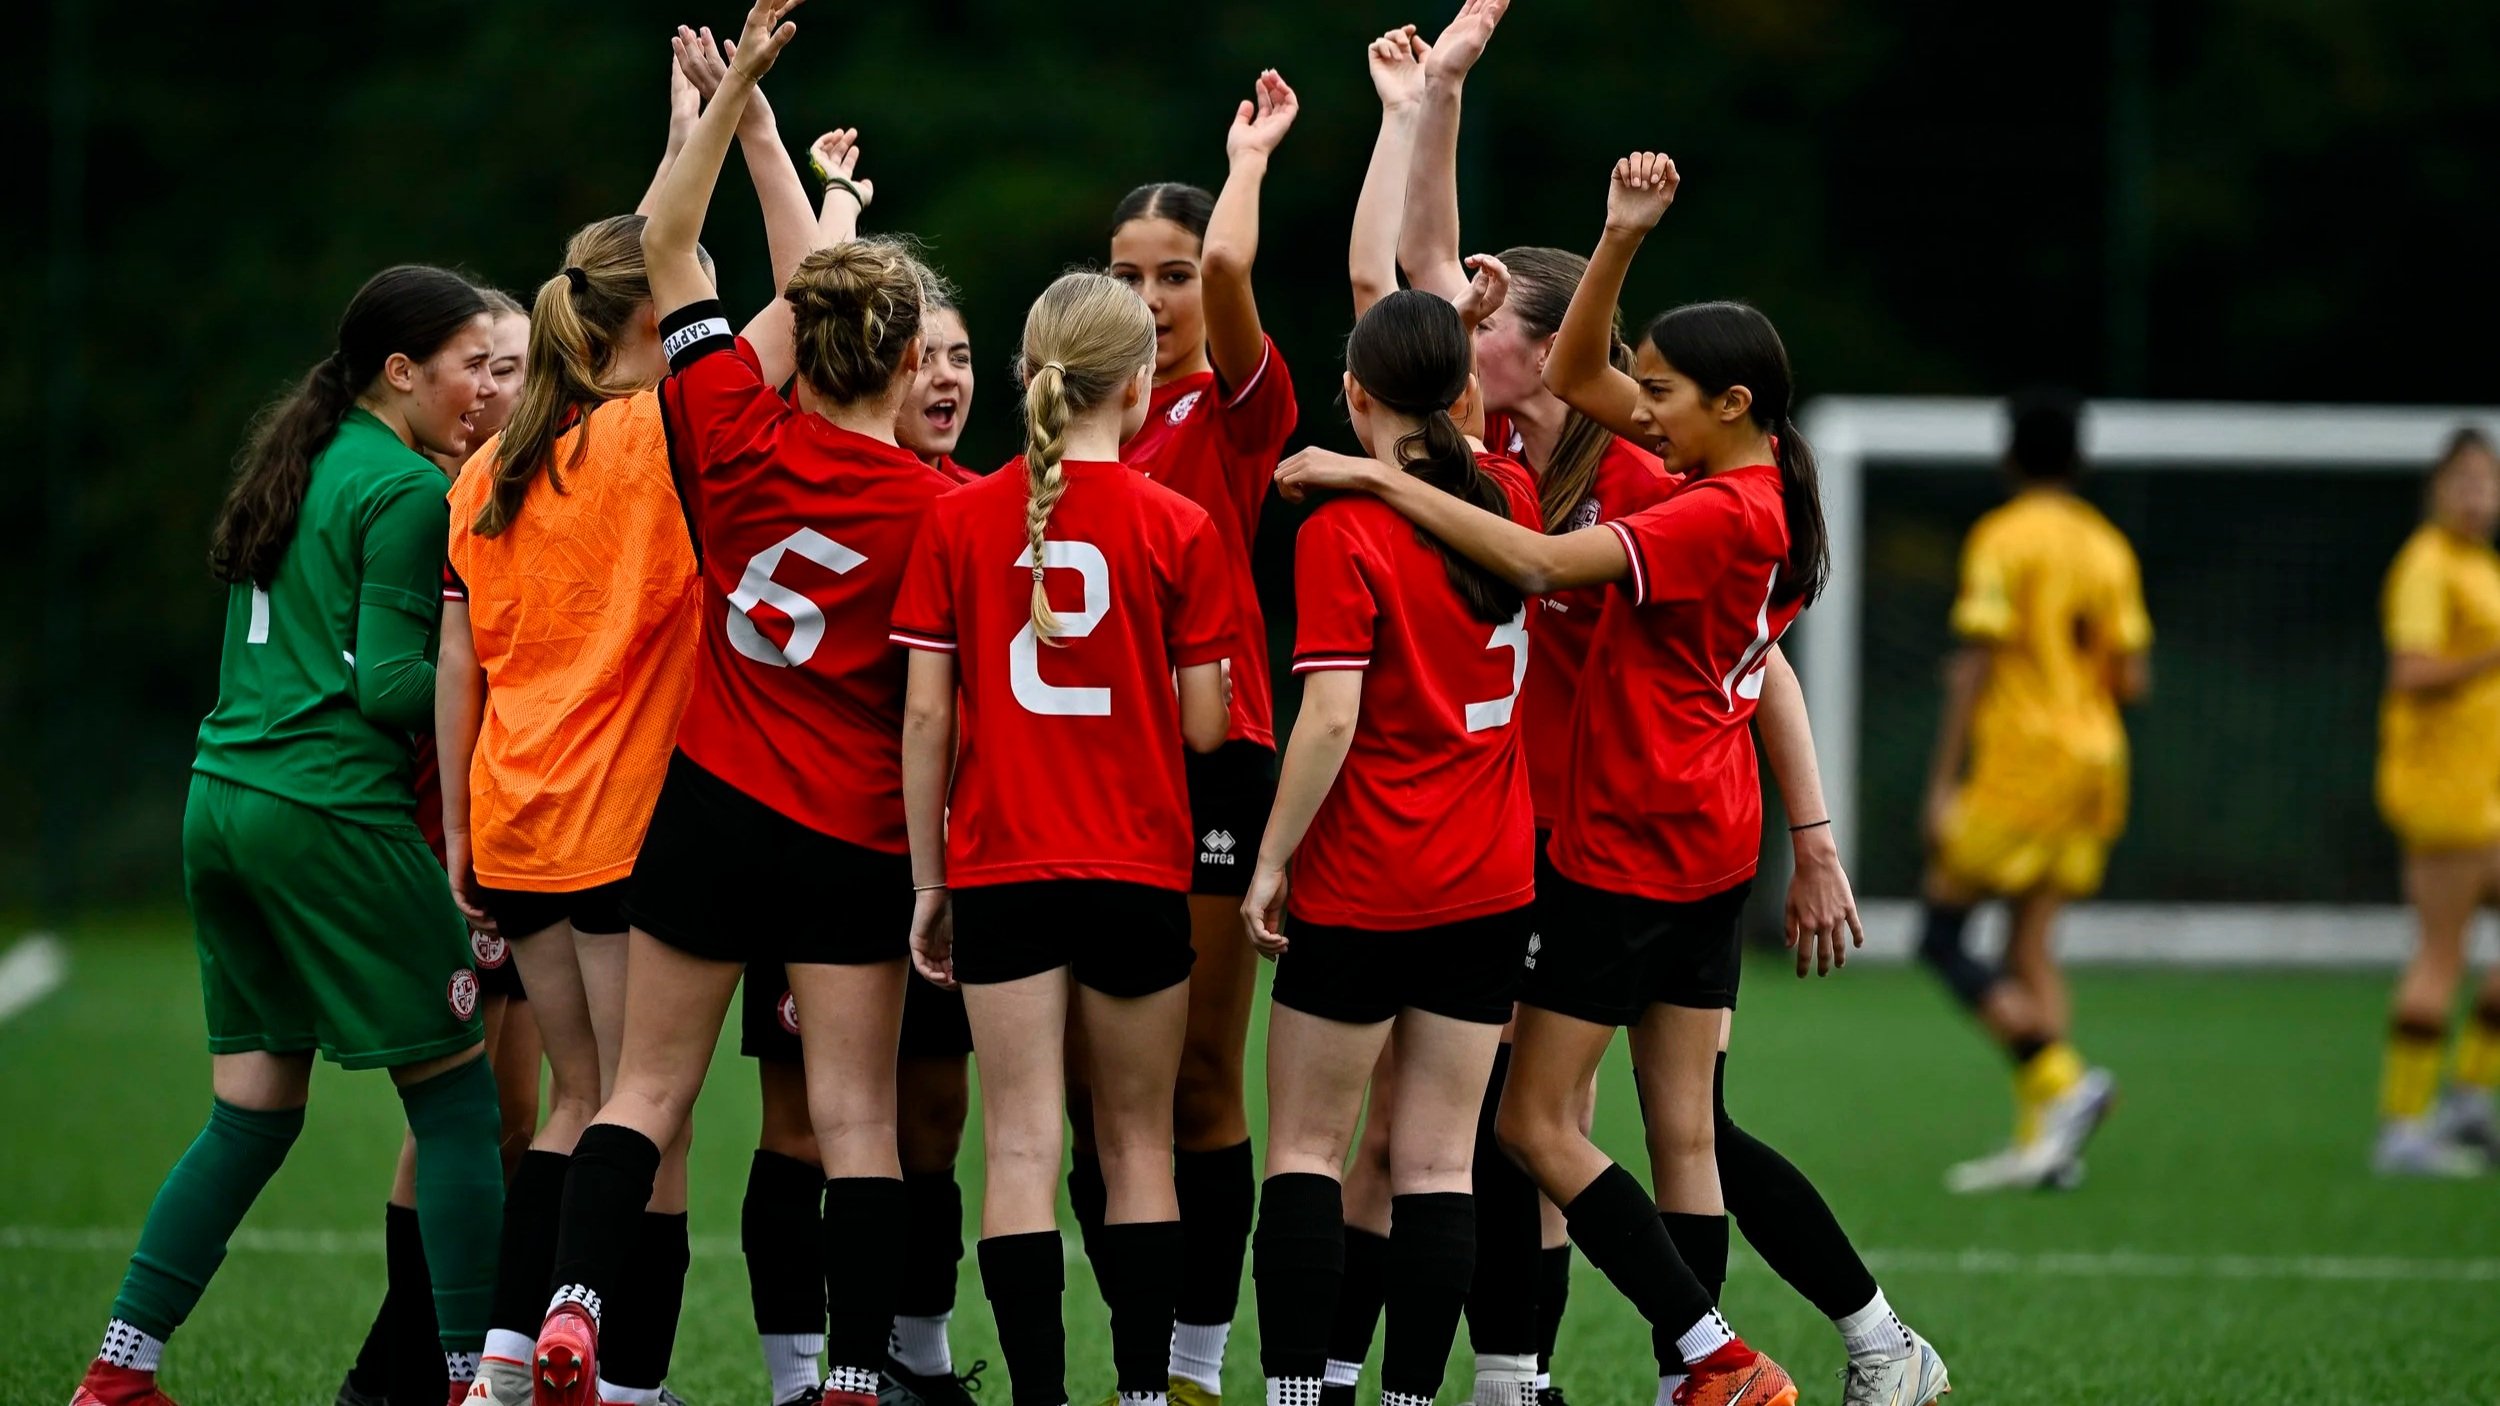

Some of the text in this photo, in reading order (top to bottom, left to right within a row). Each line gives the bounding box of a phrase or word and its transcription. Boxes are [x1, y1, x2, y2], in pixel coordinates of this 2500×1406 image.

[726, 526, 869, 668] 6
[1010, 540, 1111, 716] 2
[1465, 601, 1529, 733] 3
[1200, 851, 1235, 865] errea
